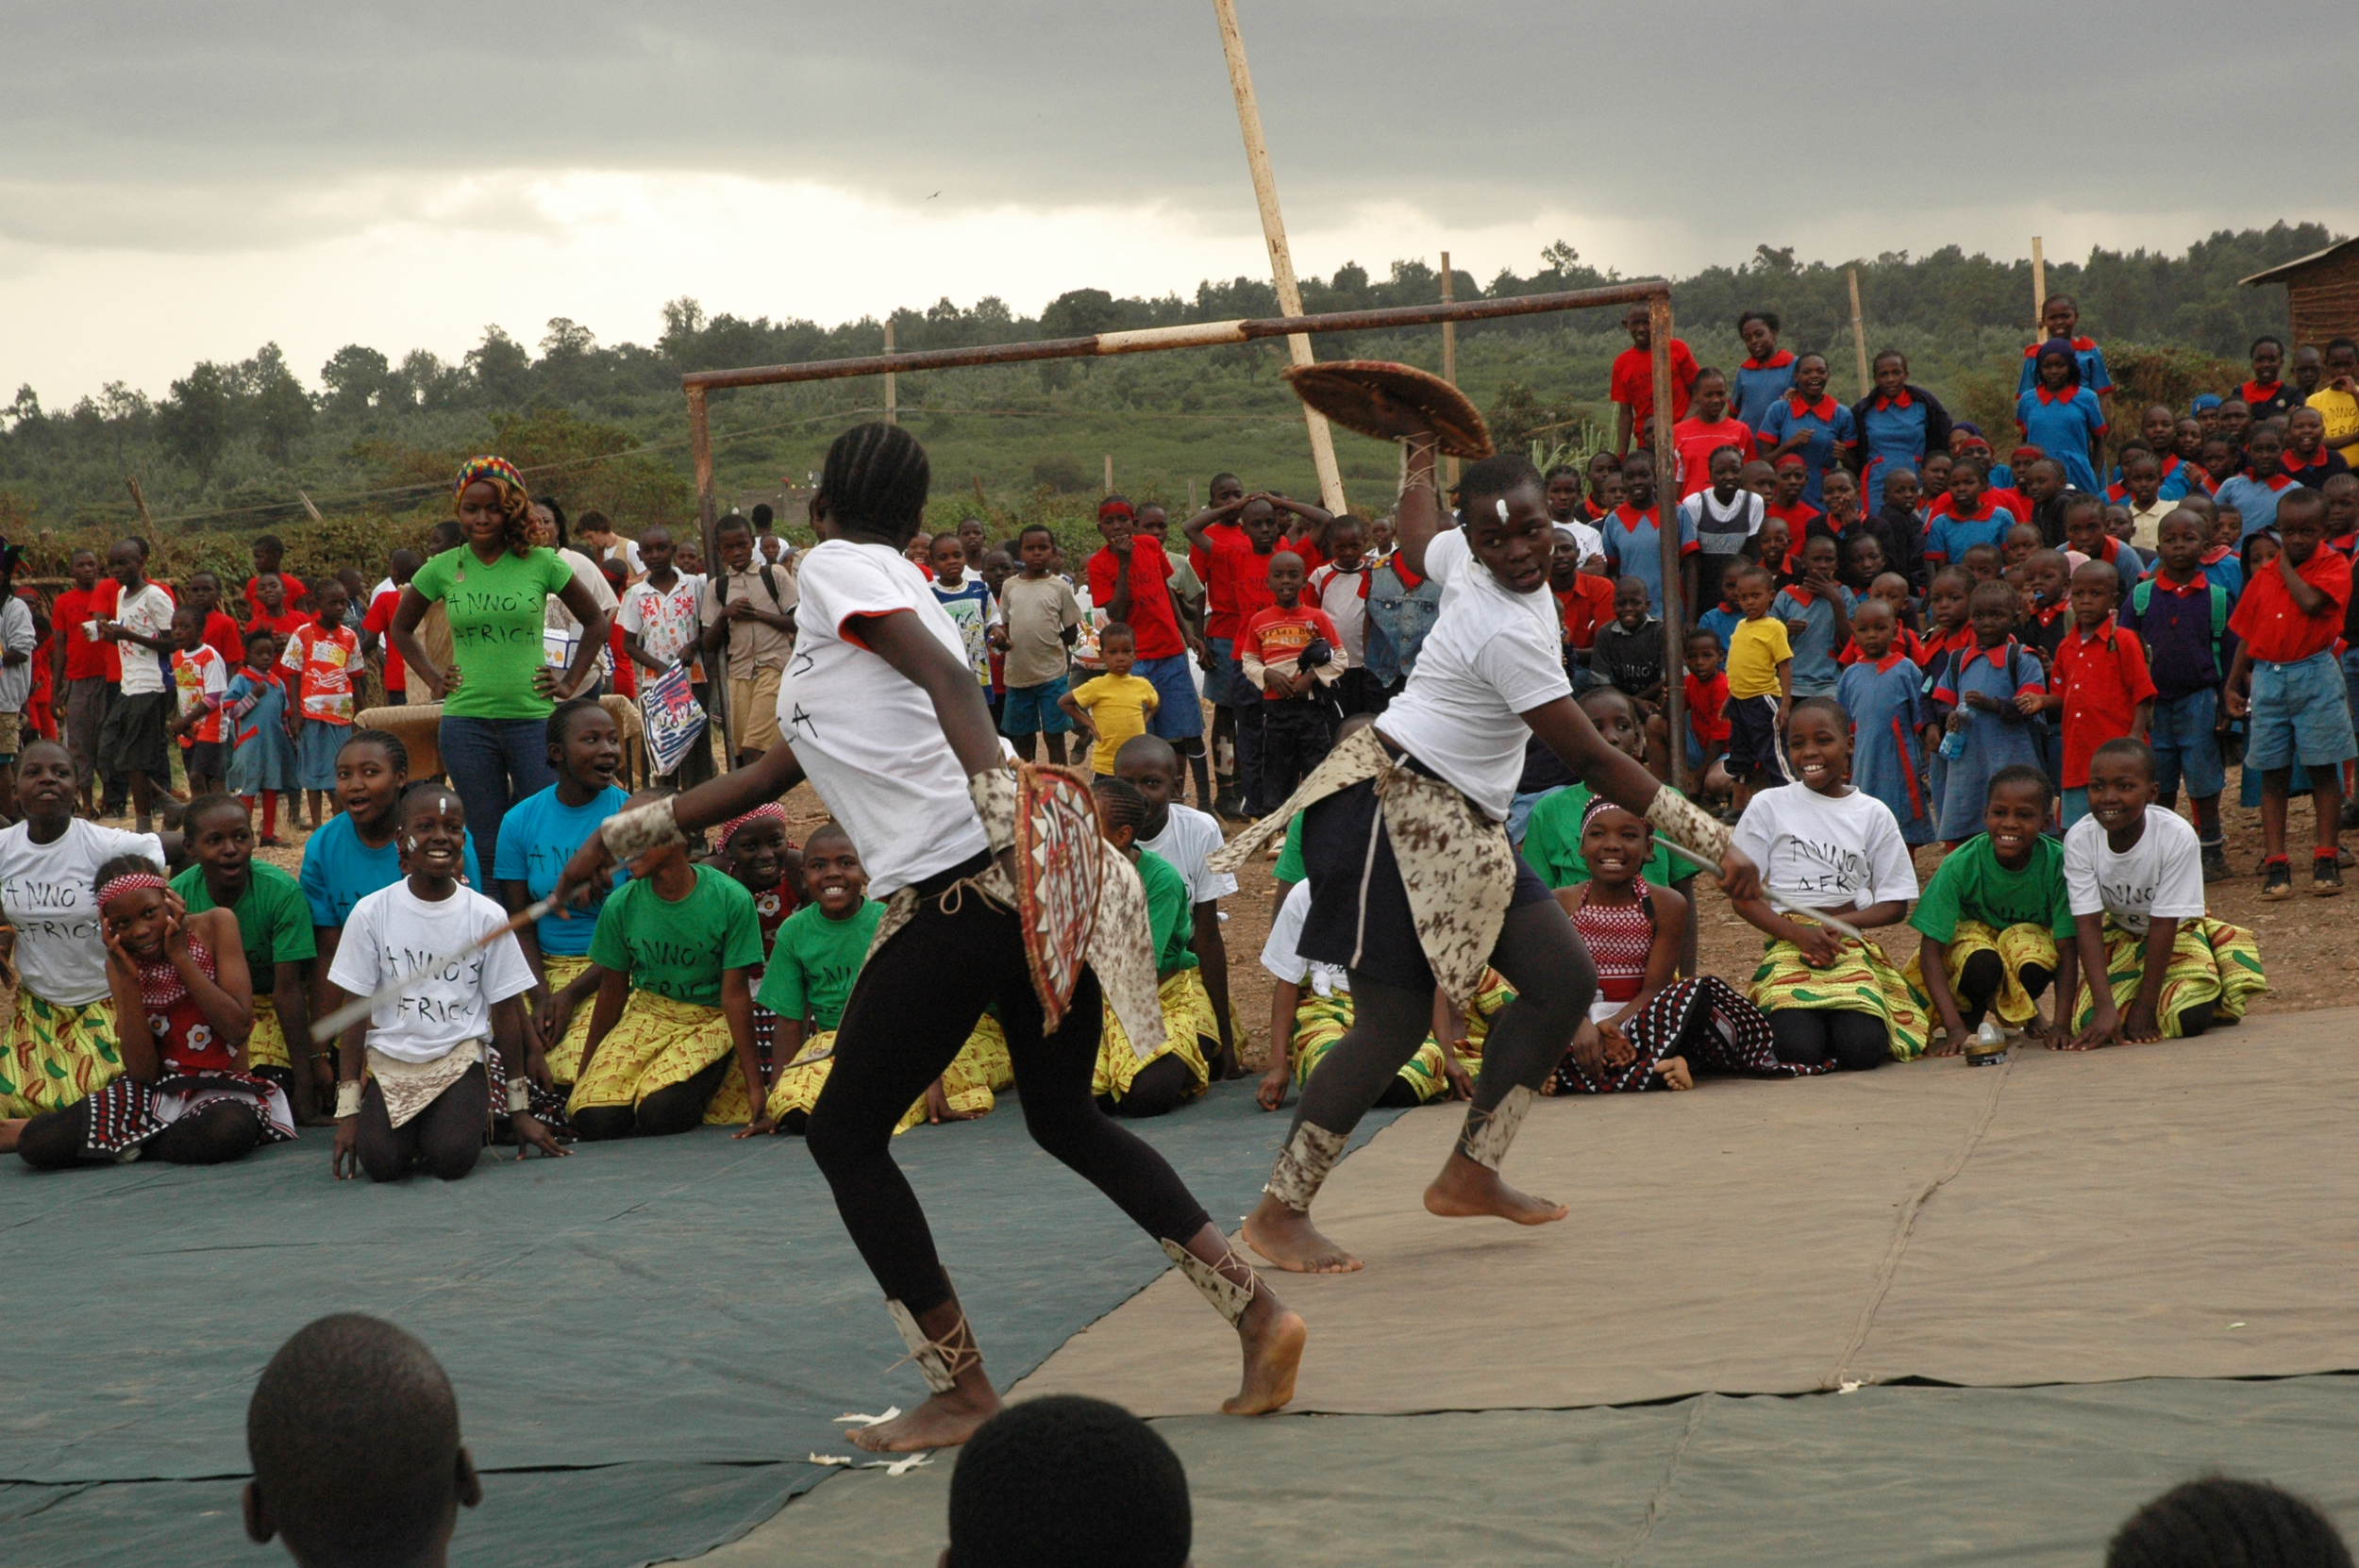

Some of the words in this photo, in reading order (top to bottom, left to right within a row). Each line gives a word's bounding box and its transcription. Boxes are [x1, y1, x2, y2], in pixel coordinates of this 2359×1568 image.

[447, 592, 540, 615] ANNO'S
[454, 624, 536, 646] AFRICA
[1790, 835, 1868, 879] ANNO'
